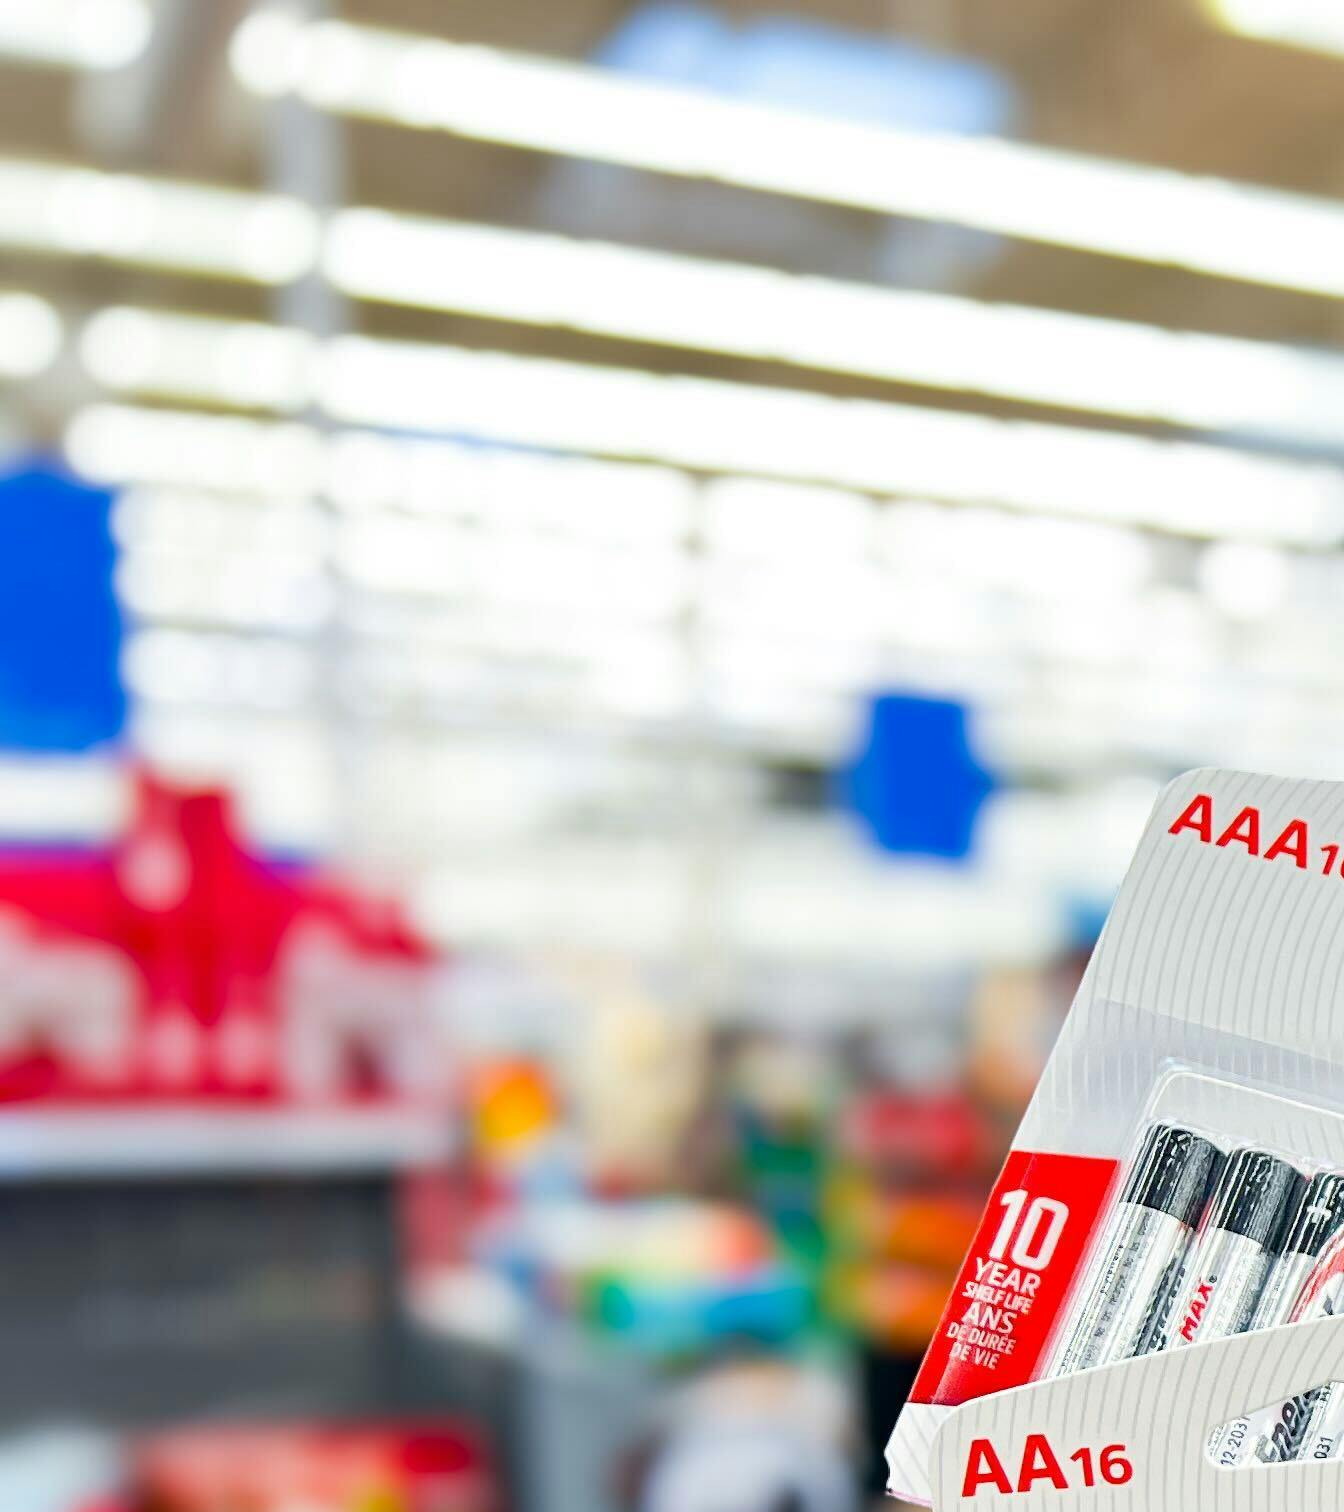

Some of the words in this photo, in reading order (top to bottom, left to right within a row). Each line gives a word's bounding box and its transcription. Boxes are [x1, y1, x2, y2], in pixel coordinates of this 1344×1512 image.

[988, 1188, 1070, 1272] 10
[975, 1256, 1041, 1298] YEAR
[962, 1281, 1006, 1307] SHELF
[1003, 1291, 1034, 1315] LIFE
[1179, 1277, 1214, 1343] MAX
[945, 1321, 969, 1342] DE
[961, 1301, 1018, 1336] ANS
[949, 1340, 972, 1363] DE
[974, 1346, 1000, 1370] VIE
